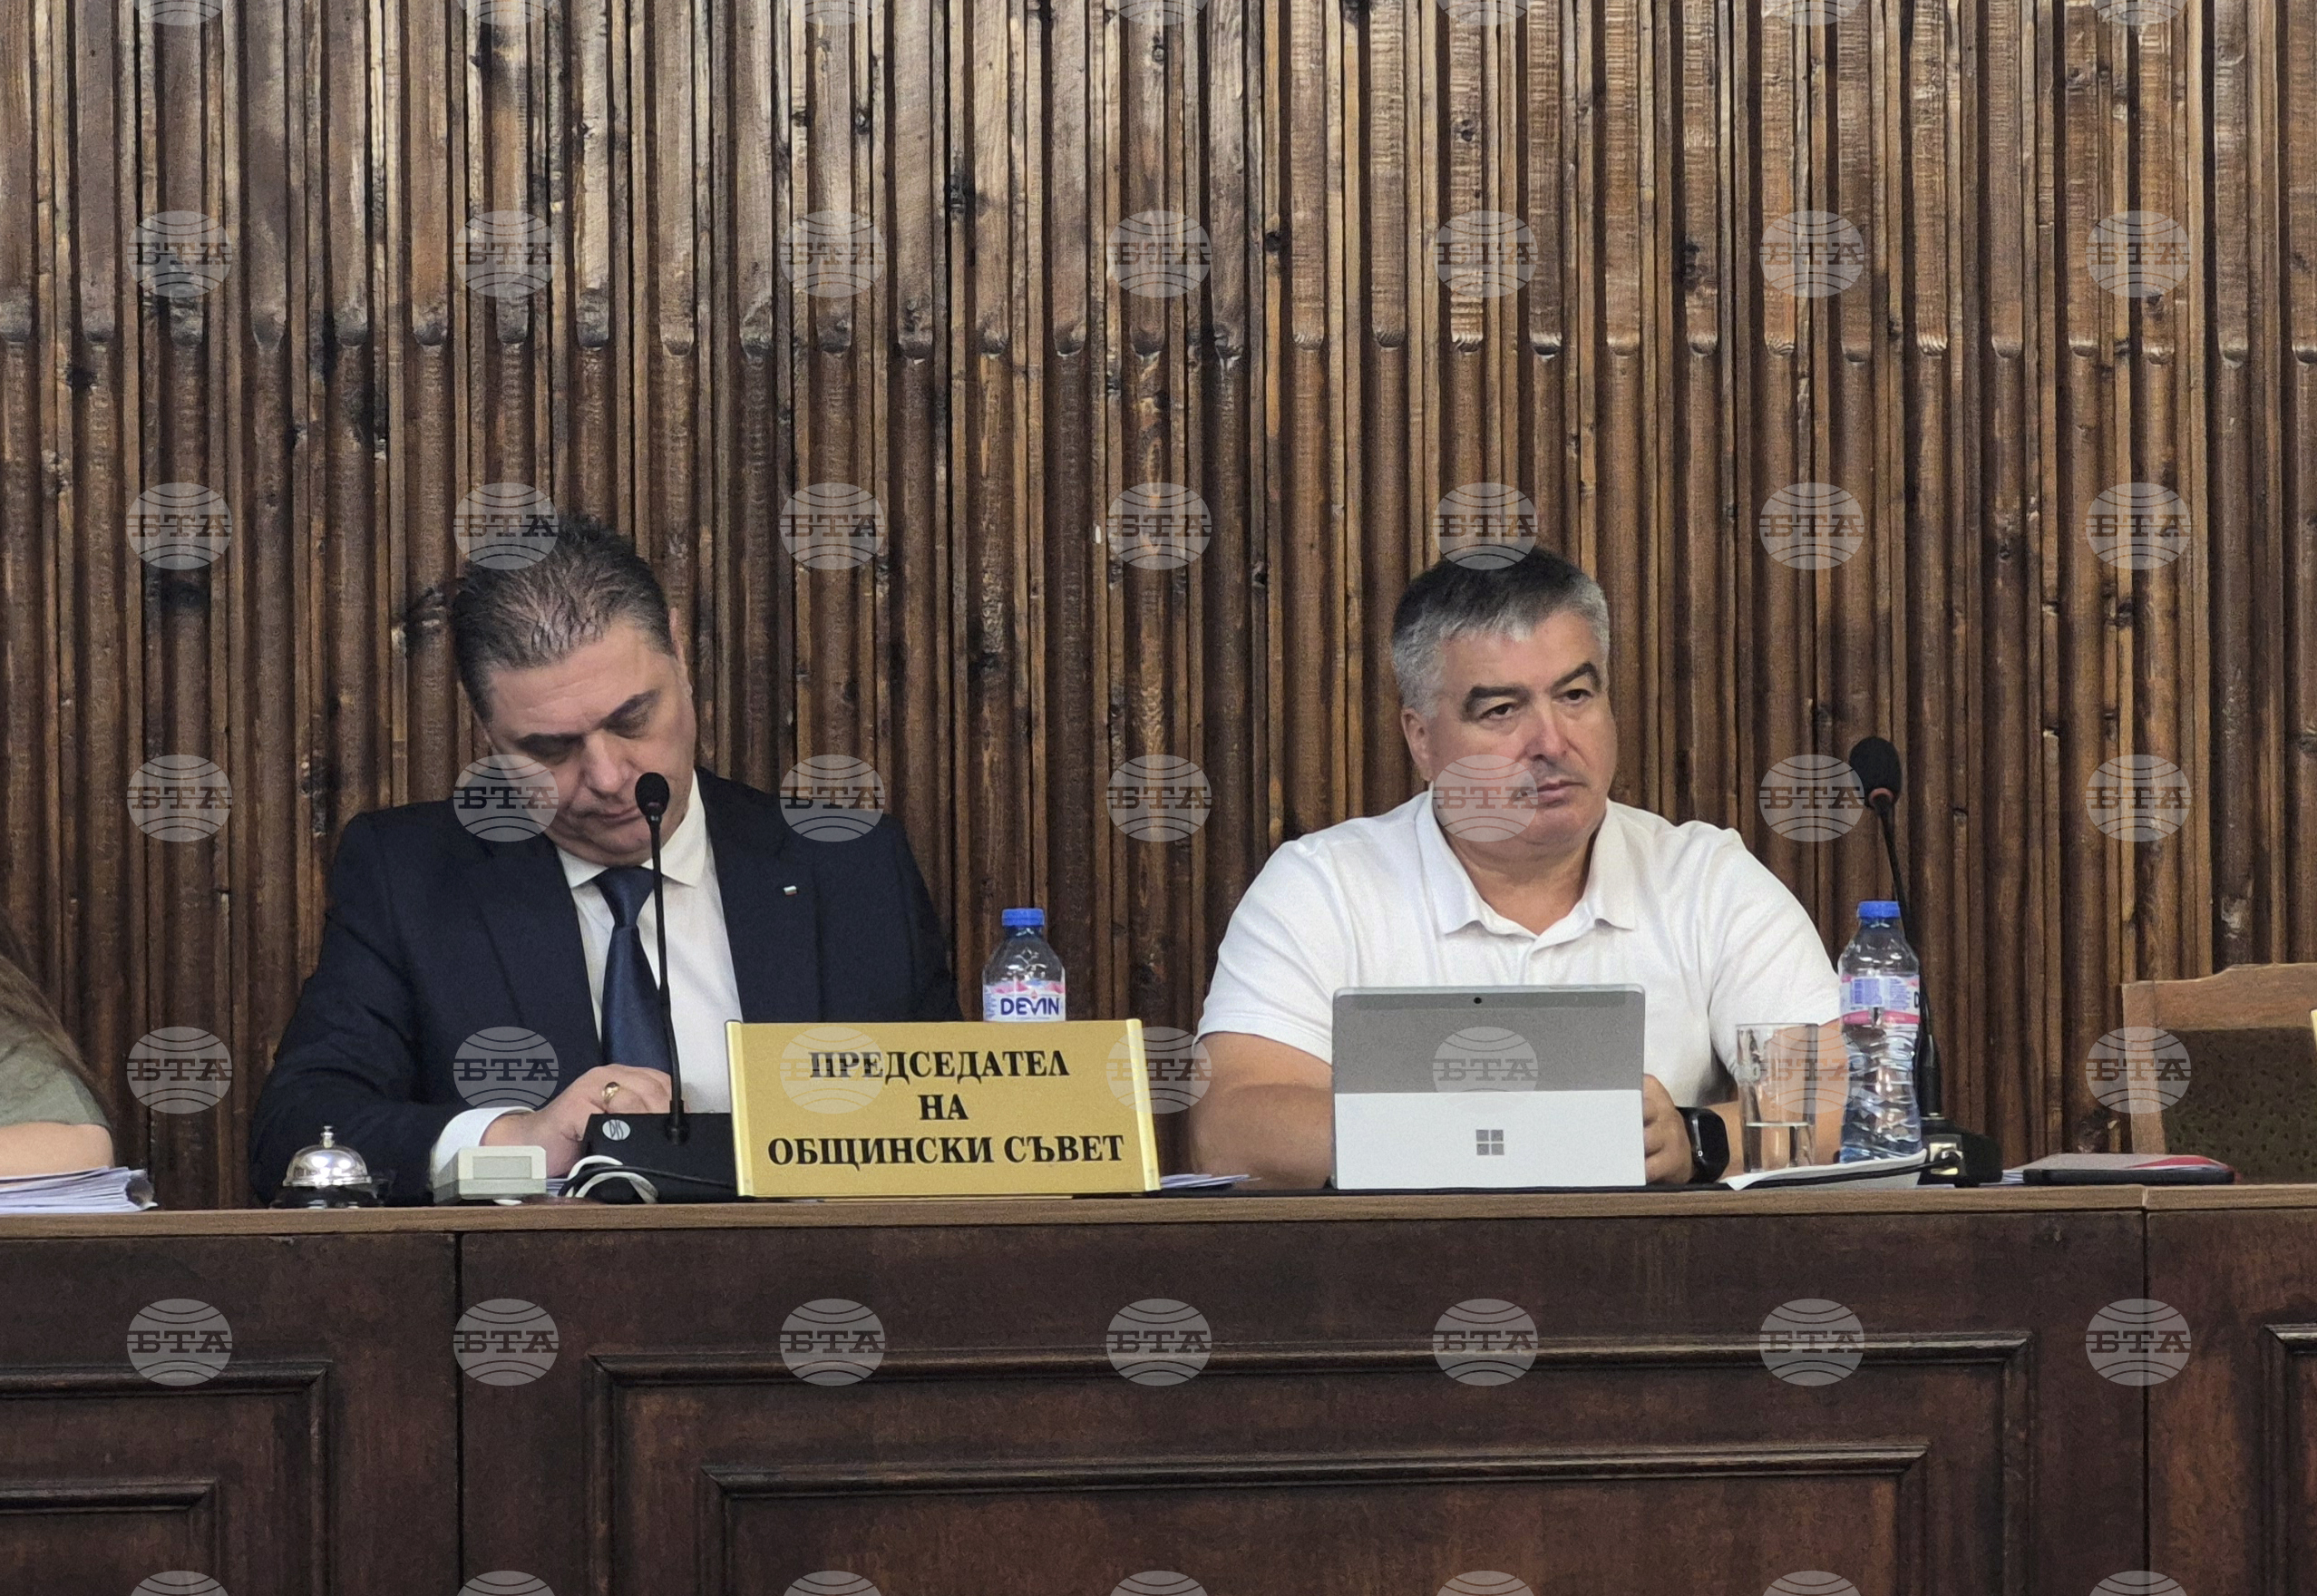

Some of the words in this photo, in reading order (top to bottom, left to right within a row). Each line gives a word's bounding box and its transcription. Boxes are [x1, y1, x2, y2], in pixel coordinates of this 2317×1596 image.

[1000, 998, 1059, 1016] DEVIN
[809, 1050, 1070, 1085] ПРЕДСЕДАТЕЛ
[919, 1094, 969, 1121] НА
[768, 1137, 994, 1171] ОБЩИНСКИ
[1004, 1135, 1124, 1163] СЪВЕТ
